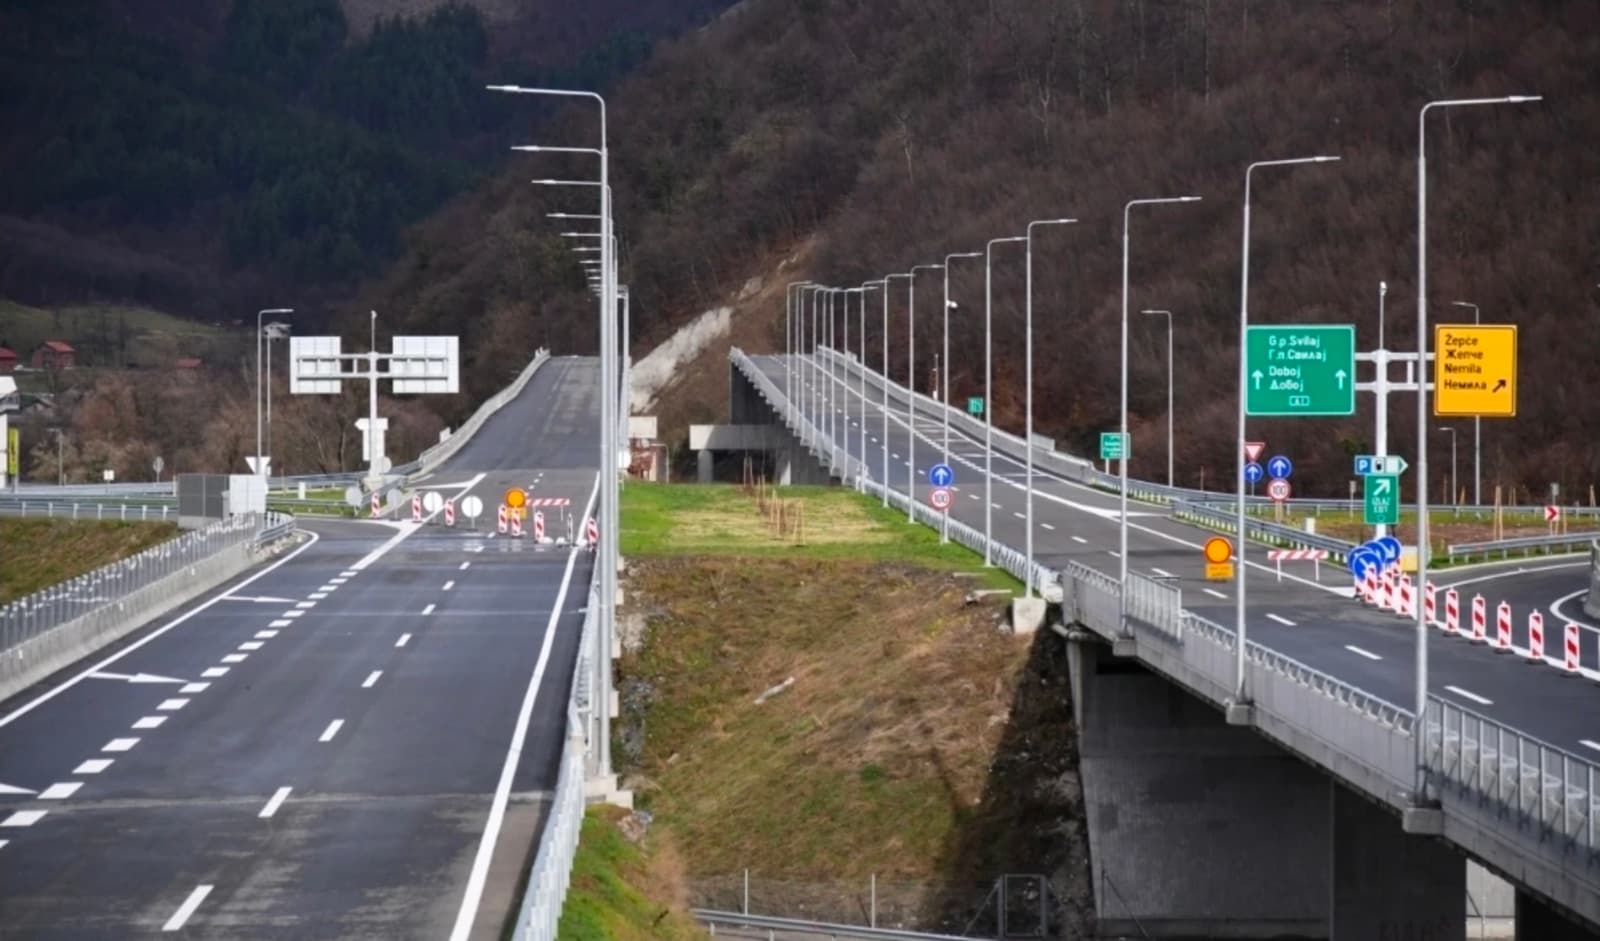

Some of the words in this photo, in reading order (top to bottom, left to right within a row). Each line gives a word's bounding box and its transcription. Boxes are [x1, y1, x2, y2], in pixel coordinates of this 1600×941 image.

[1268, 365, 1301, 379] Doboj
[1444, 363, 1482, 374] Nemila
[1359, 459, 1369, 471] P
